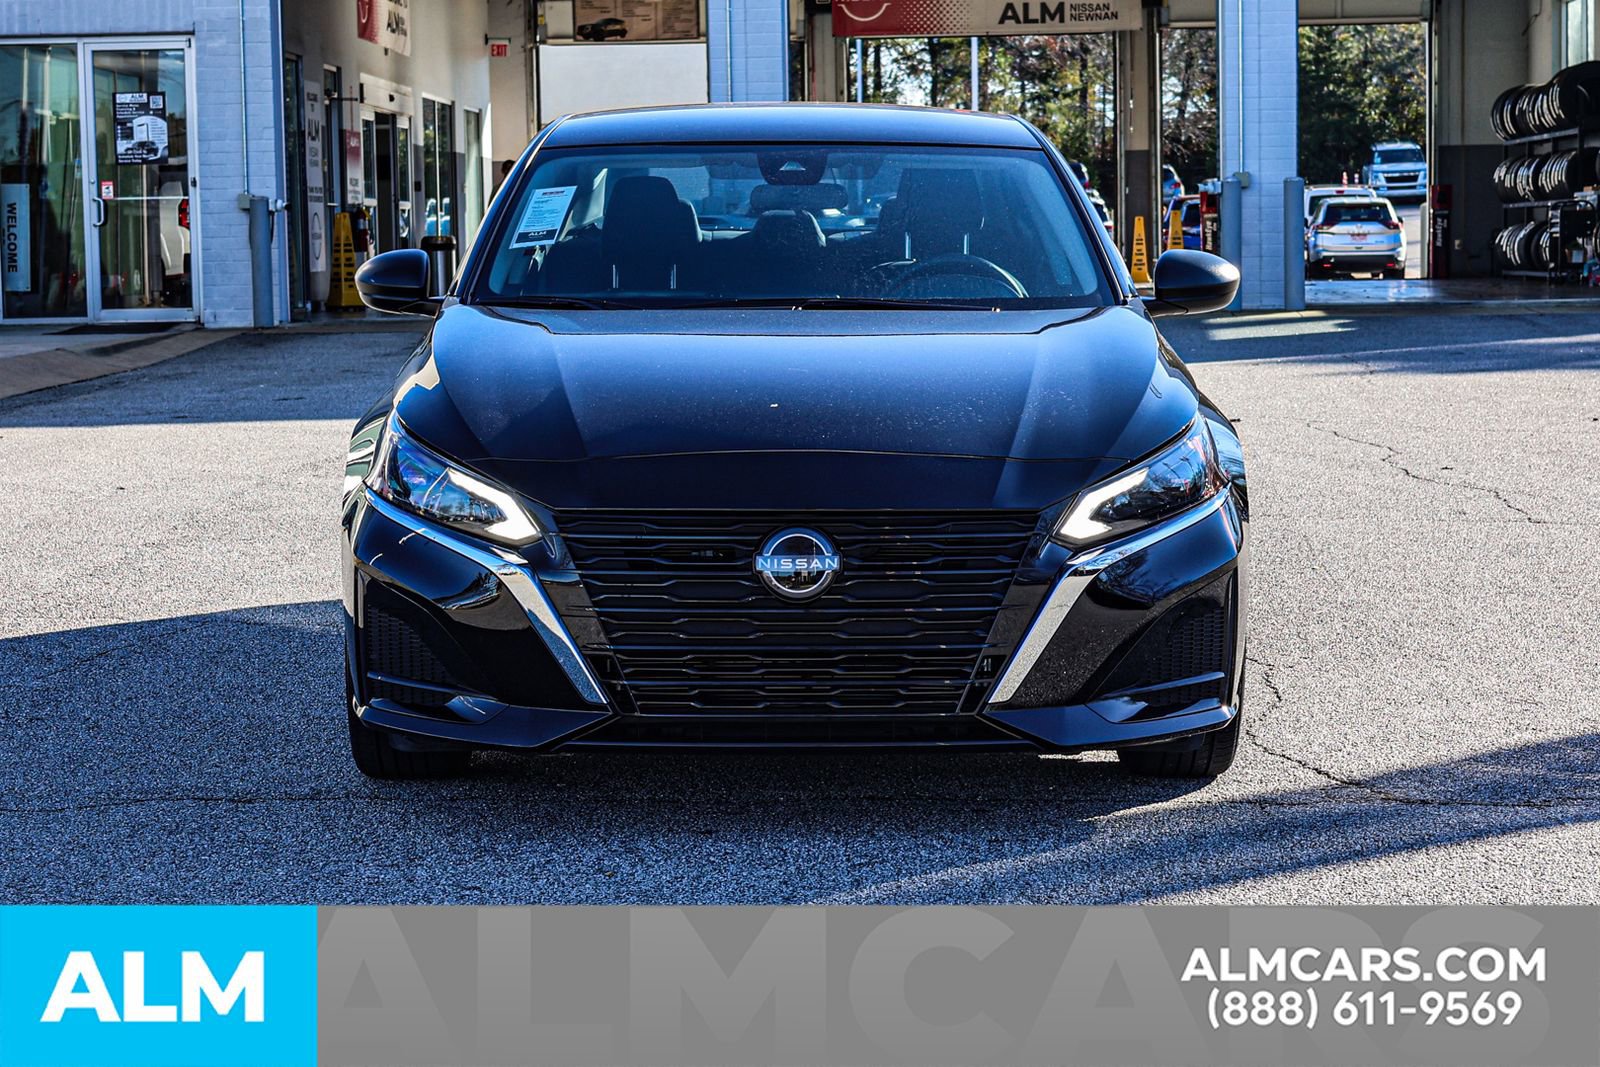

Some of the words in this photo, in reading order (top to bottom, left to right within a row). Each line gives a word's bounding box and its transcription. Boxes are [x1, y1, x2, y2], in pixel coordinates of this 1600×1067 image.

[997, 2, 1065, 24] ALM
[1069, 3, 1111, 12] NISSAN
[1069, 11, 1119, 21] NEWNAN
[7, 202, 18, 273] WELCOME
[758, 558, 838, 569] NISSAN
